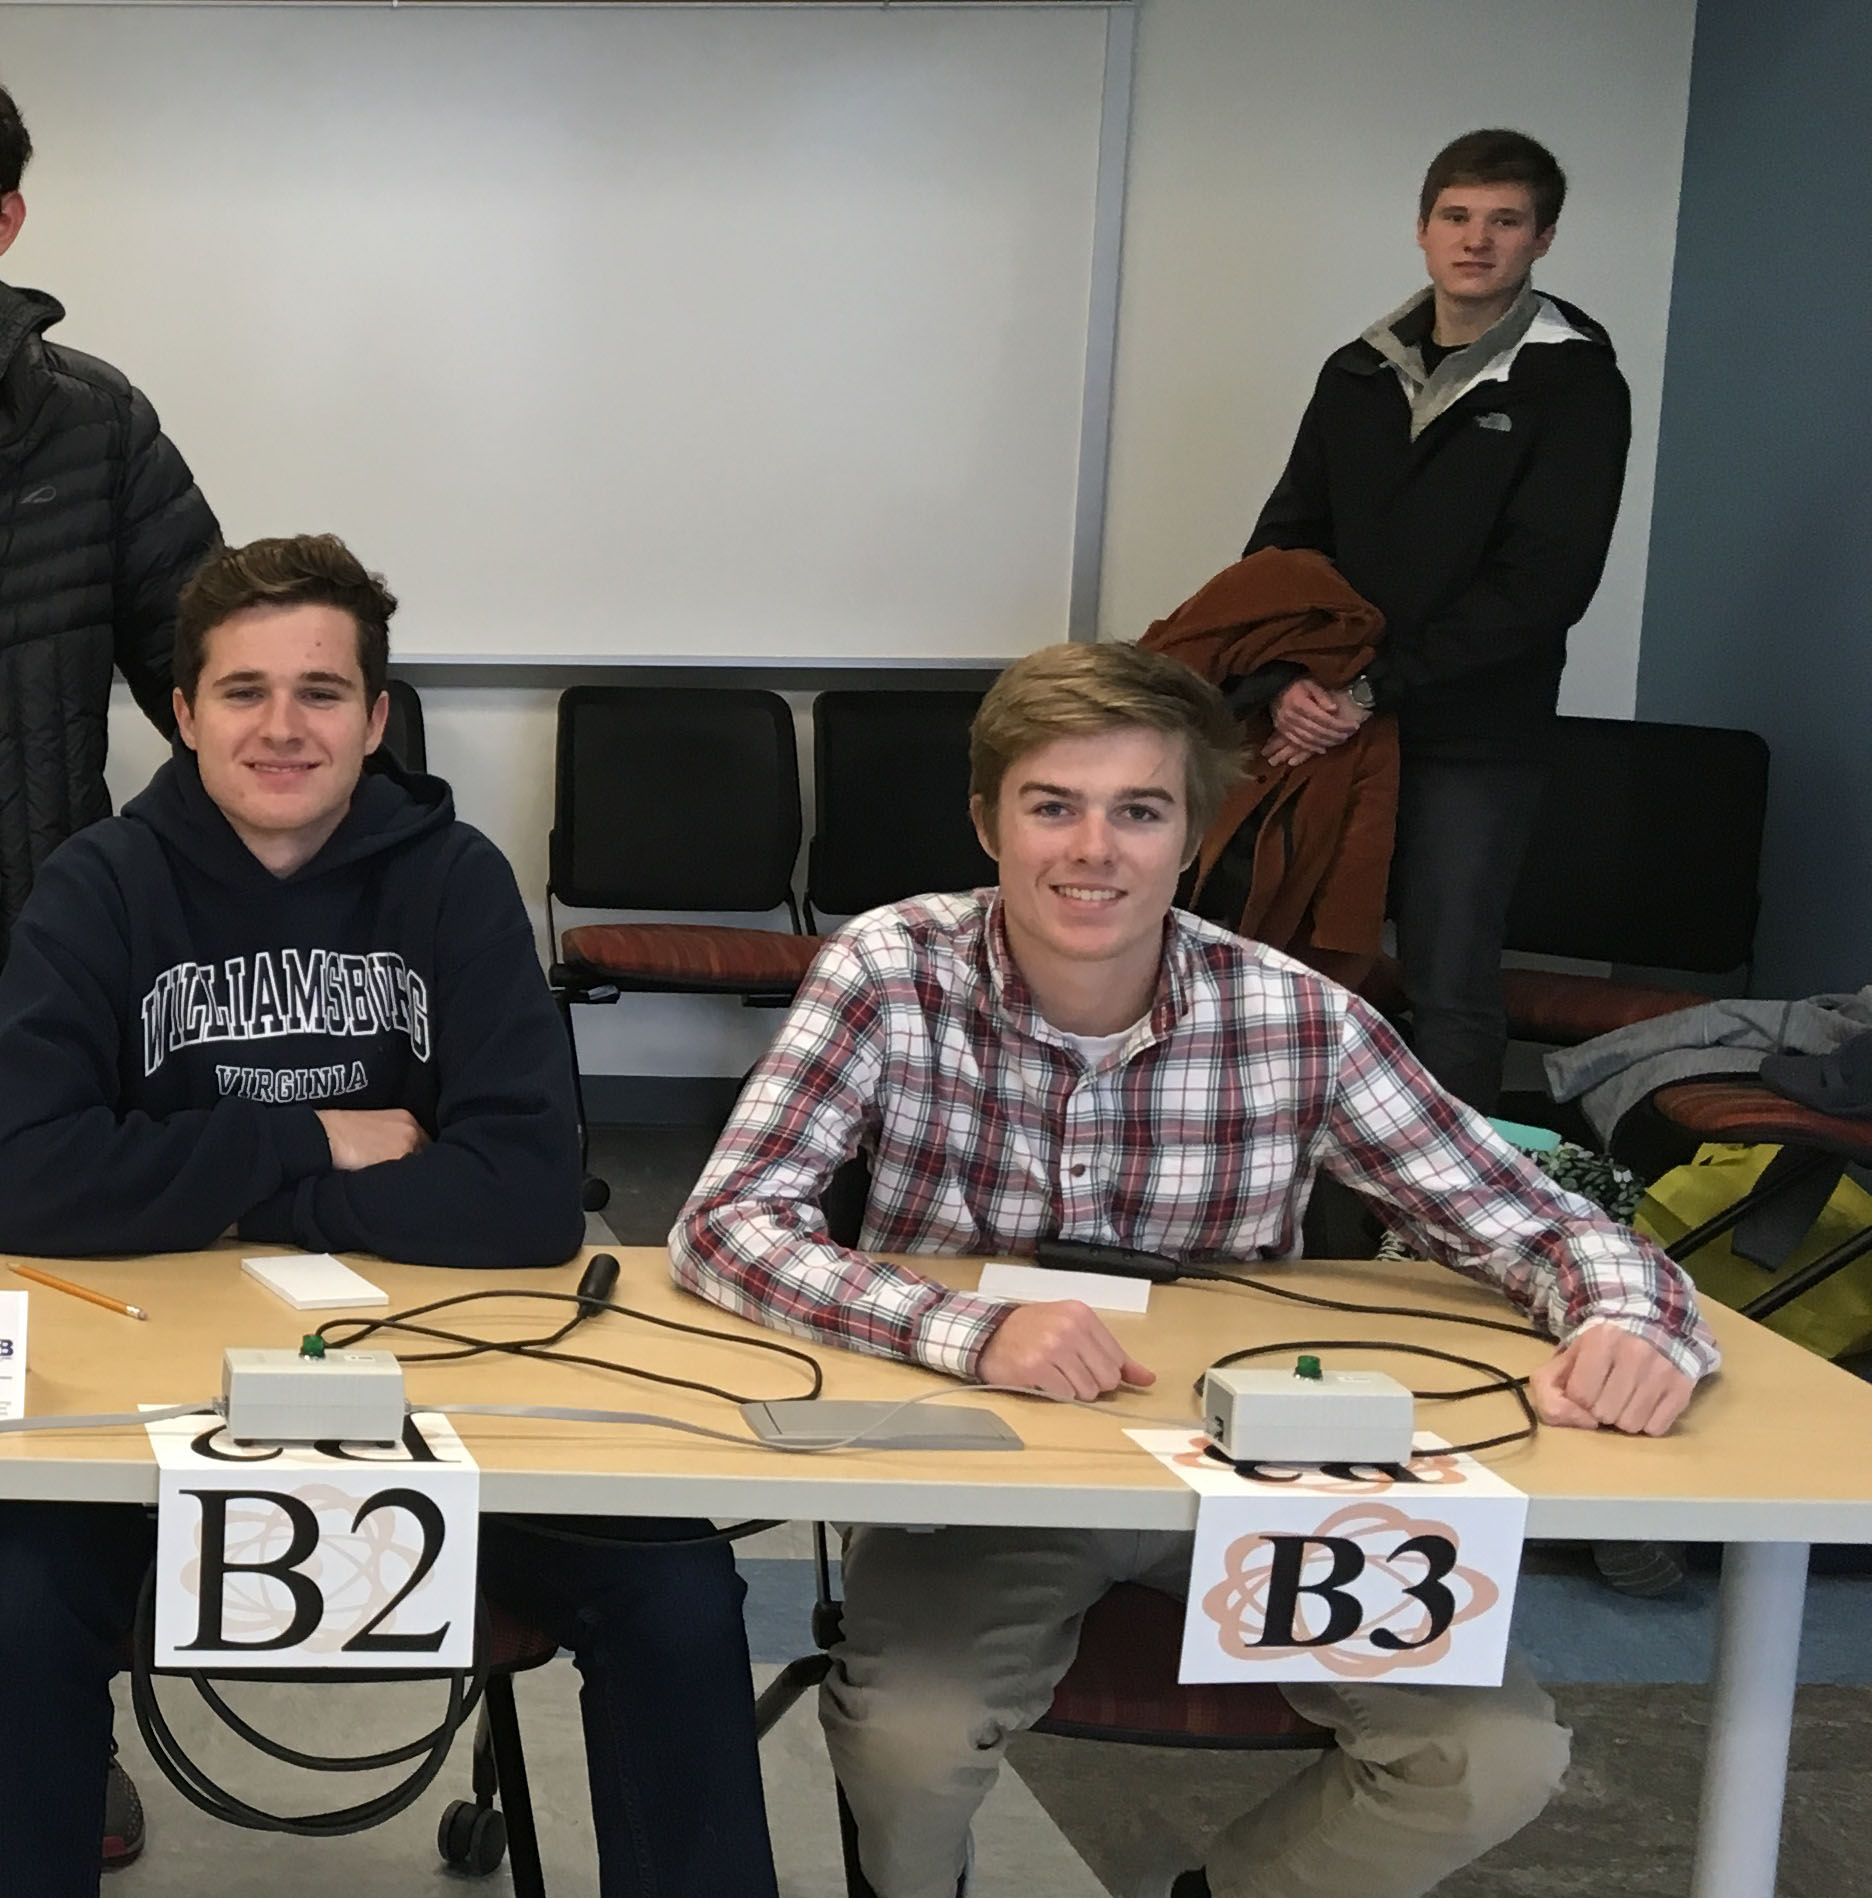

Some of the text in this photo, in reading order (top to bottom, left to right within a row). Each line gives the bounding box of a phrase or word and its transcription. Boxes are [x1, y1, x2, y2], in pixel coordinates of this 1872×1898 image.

[216, 1061, 368, 1103] VIRGINIA
[174, 1487, 451, 1653] B2
[1244, 1534, 1458, 1651] B3
